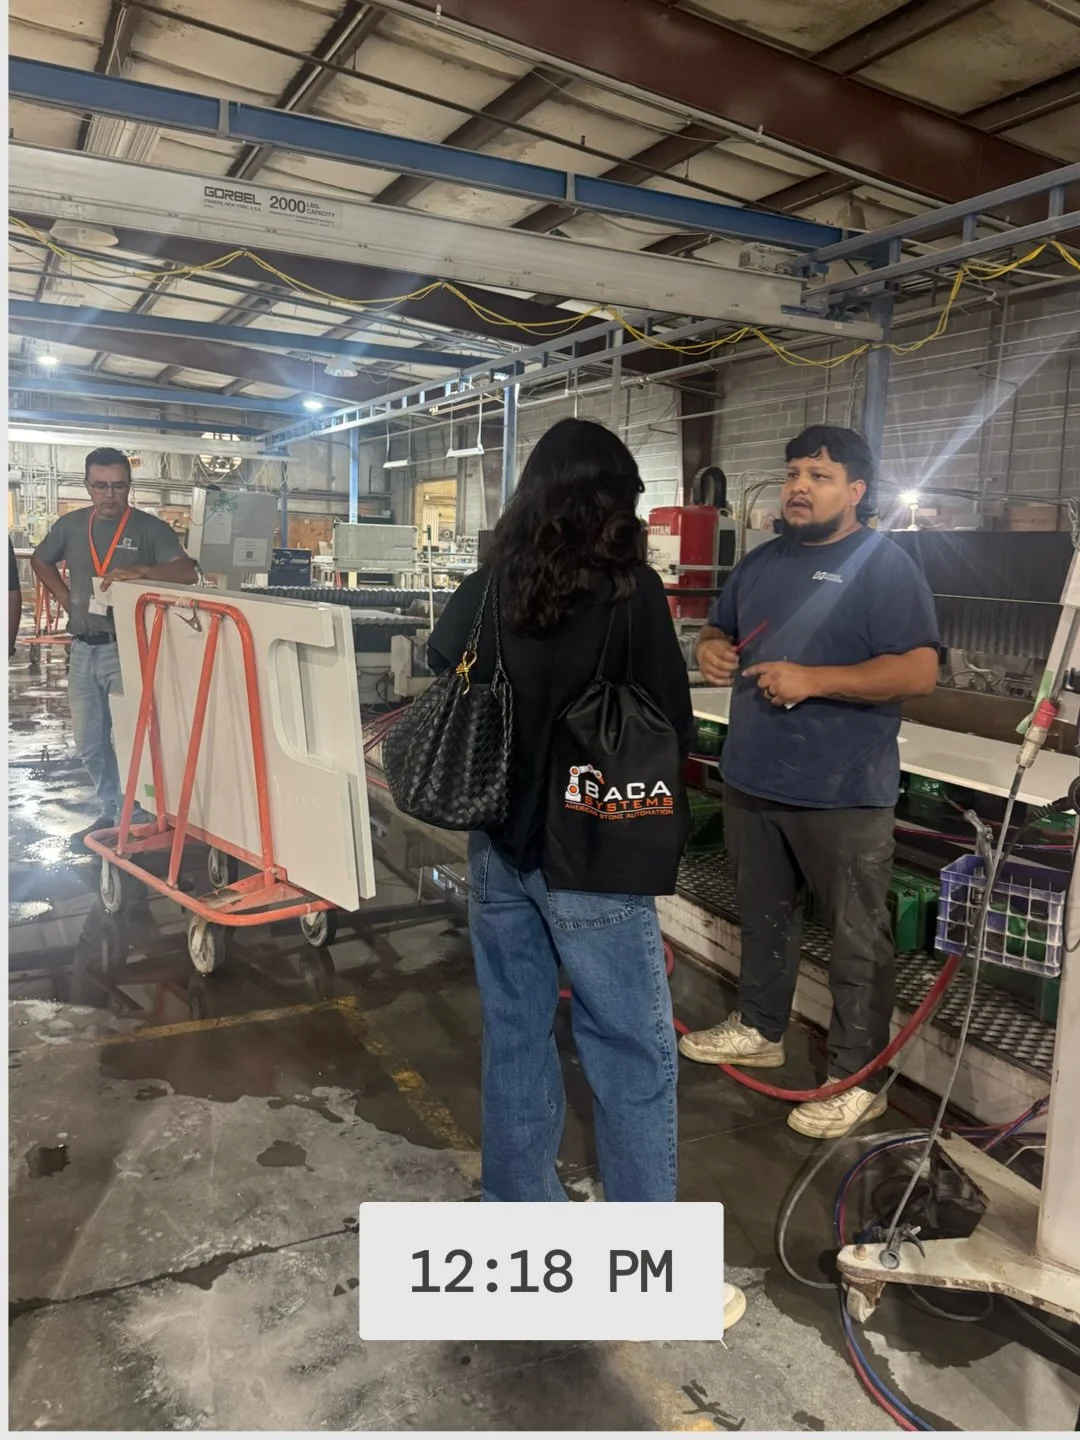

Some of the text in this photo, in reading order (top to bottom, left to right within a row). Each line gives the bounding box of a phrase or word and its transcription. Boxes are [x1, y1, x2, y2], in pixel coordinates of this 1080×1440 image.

[204, 186, 262, 205] GORBEL
[270, 195, 305, 213] 2000
[307, 208, 335, 218] CAPACITY
[585, 780, 672, 802] BACA
[565, 803, 598, 817] AMERICAN
[626, 808, 673, 819] AUTOMATION
[584, 796, 673, 812] SYSTEMS
